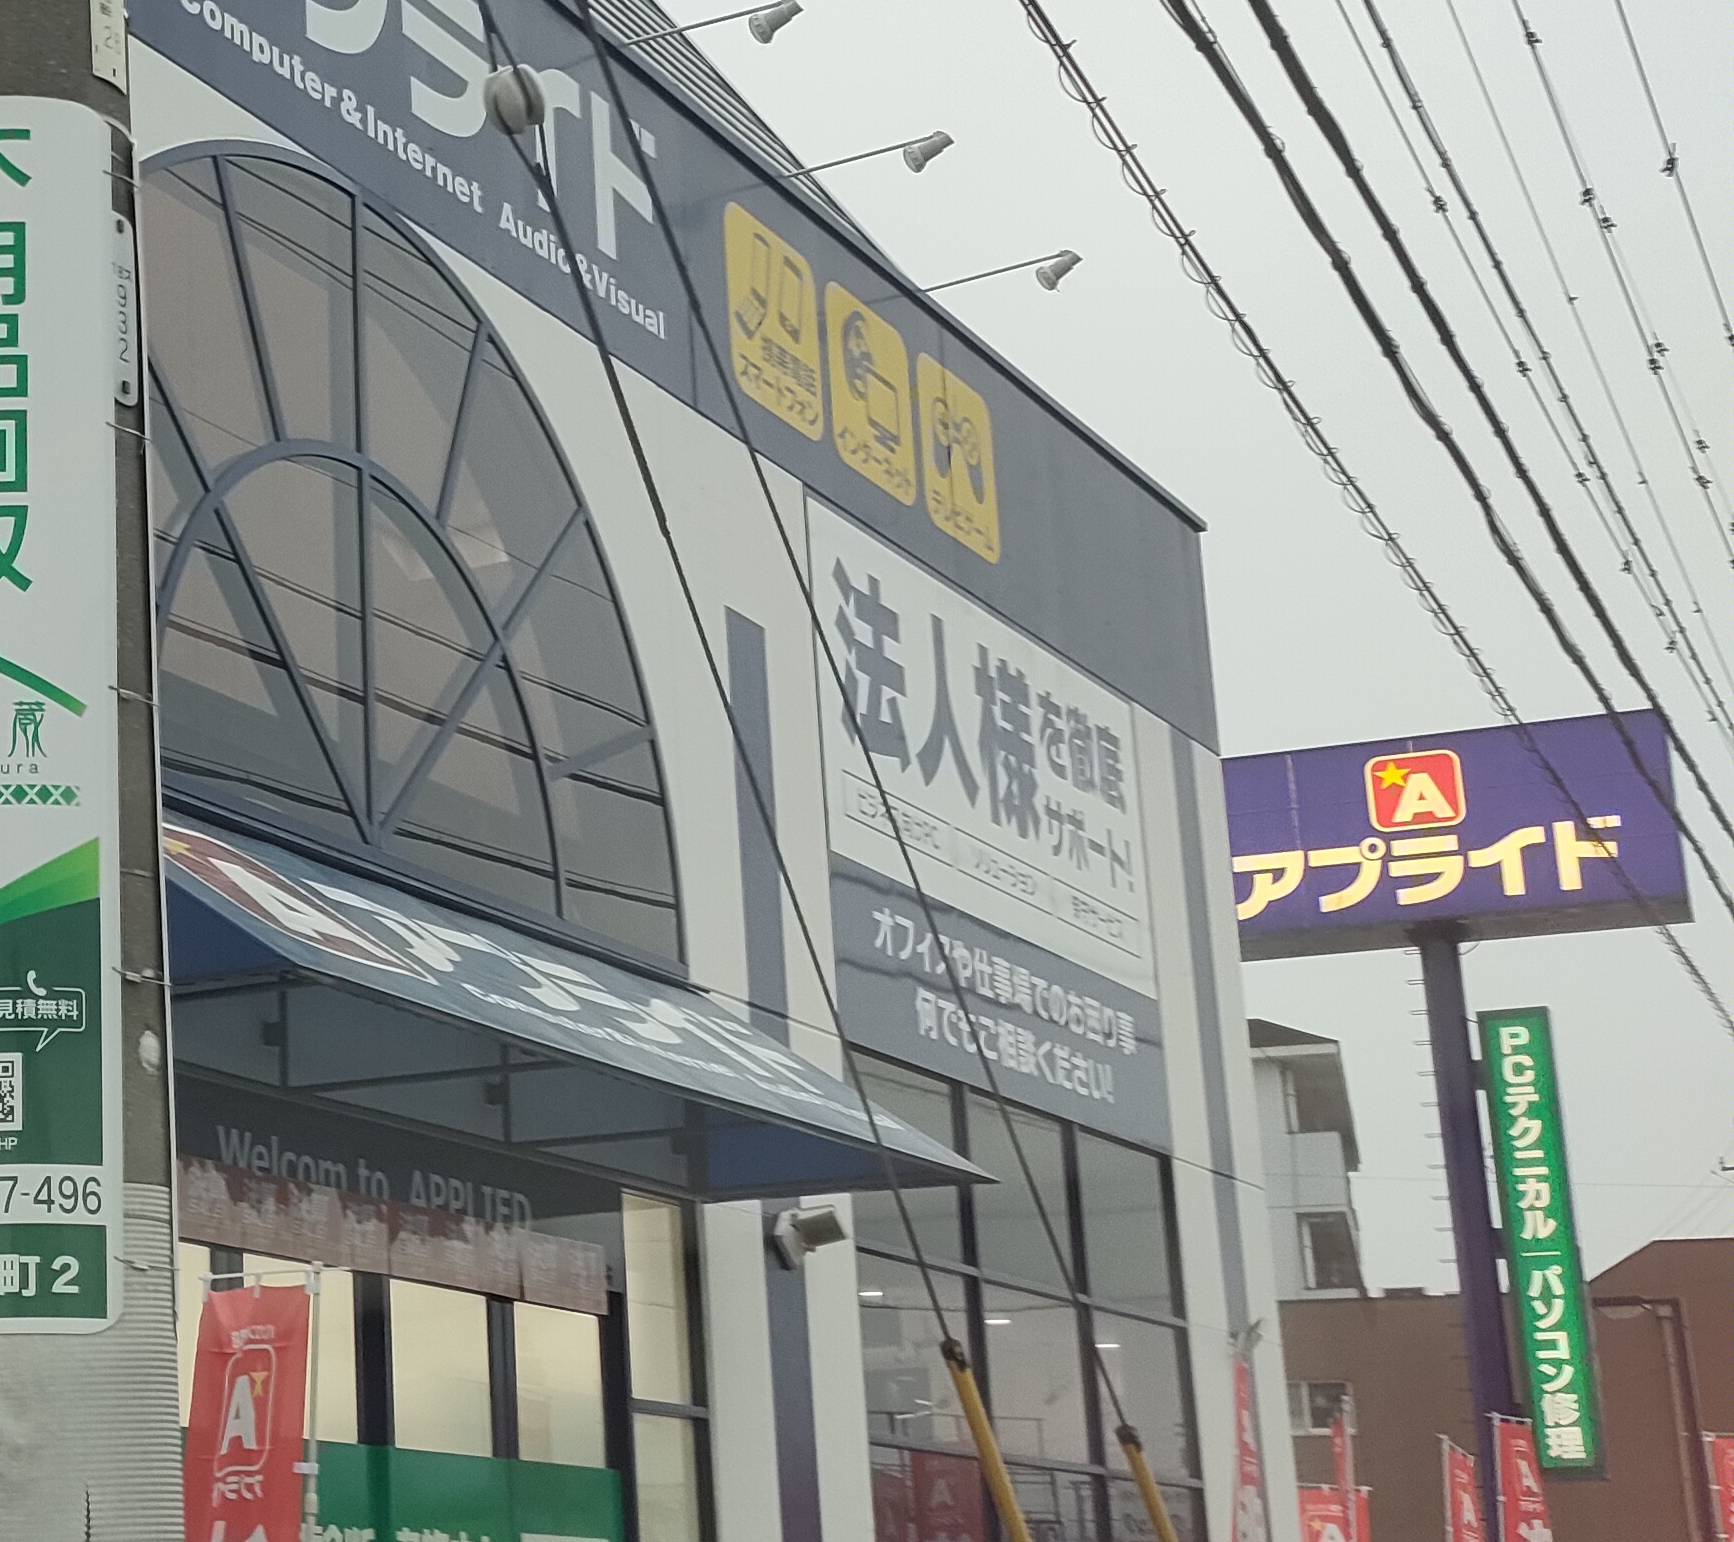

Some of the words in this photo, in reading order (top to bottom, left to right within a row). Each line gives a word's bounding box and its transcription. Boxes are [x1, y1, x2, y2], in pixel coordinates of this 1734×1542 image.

[1392, 773, 1455, 822] A
[1232, 815, 1621, 921] アプライド
[357, 1158, 390, 1200] to
[1498, 1025, 1556, 1240] PCテクニカル
[1528, 1266, 1588, 1460] パソコン修理
